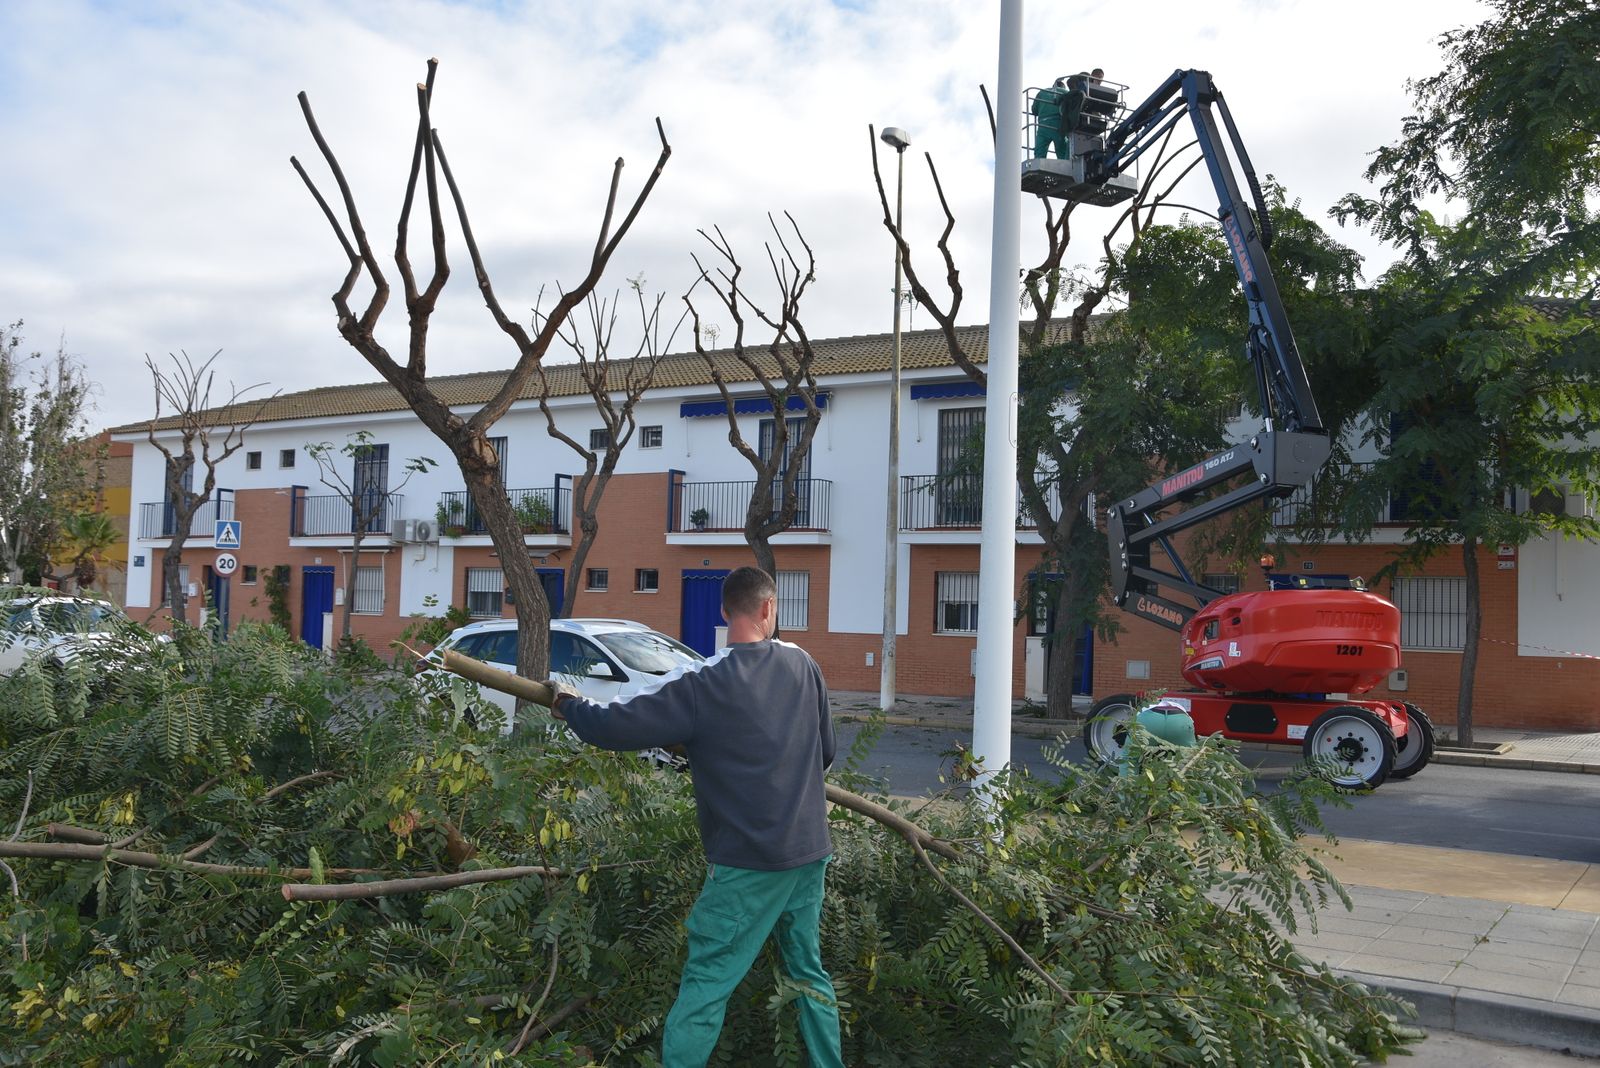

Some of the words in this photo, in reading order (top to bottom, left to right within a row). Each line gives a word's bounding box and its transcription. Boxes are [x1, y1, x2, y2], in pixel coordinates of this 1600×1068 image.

[1231, 226, 1253, 283] LOZANO
[1162, 465, 1204, 497] MANITOU
[1205, 458, 1220, 471] 160
[1220, 451, 1234, 464] ATJ
[219, 558, 235, 569] 20
[1145, 600, 1183, 625] LOZANO
[1336, 644, 1364, 657] 1201
